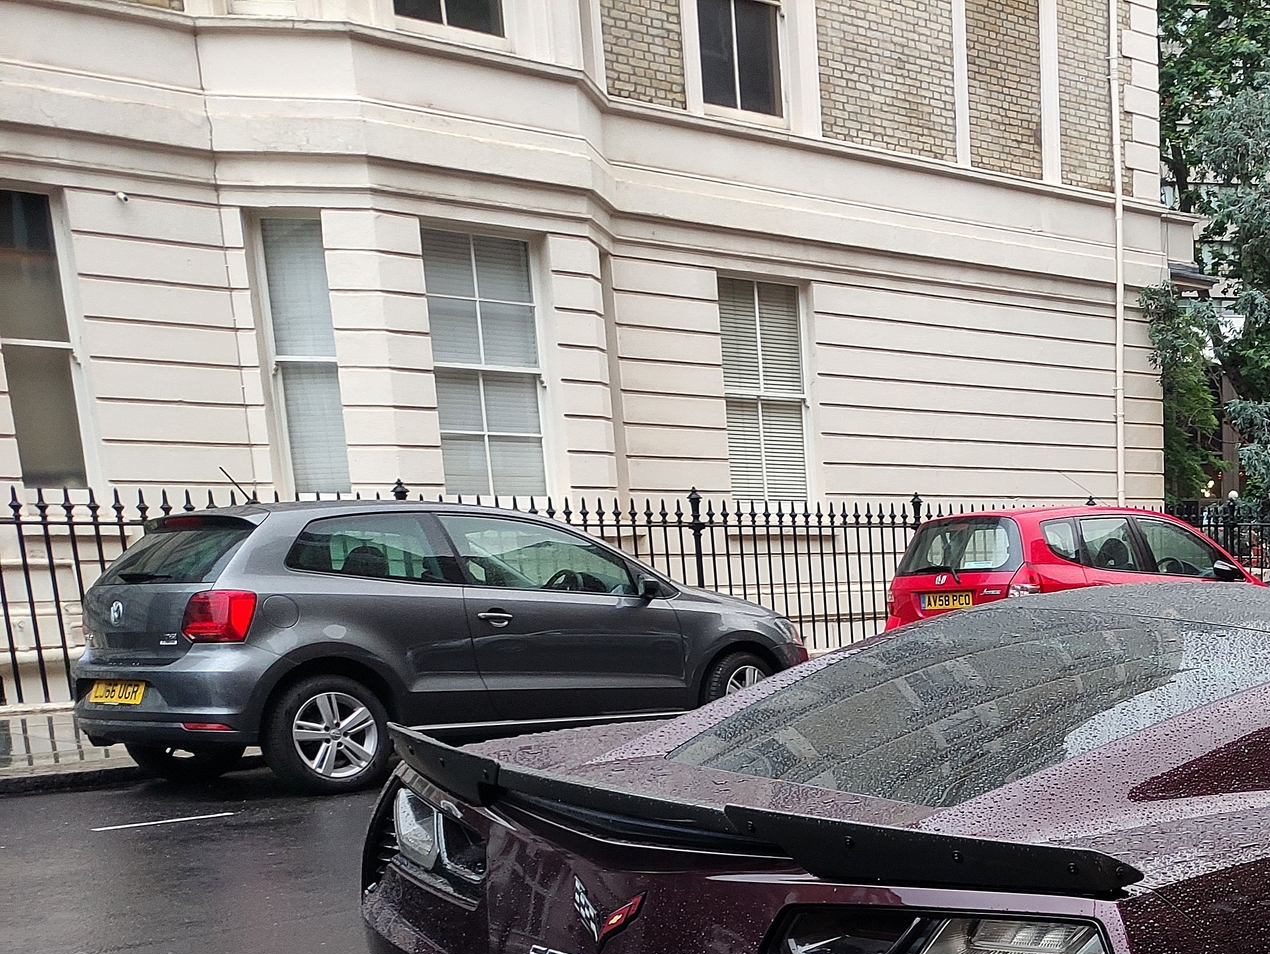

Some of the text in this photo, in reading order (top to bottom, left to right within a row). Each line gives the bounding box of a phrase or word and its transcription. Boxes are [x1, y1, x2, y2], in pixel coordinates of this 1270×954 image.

[927, 594, 971, 607] AV58 PCO
[118, 683, 140, 701] UGR
